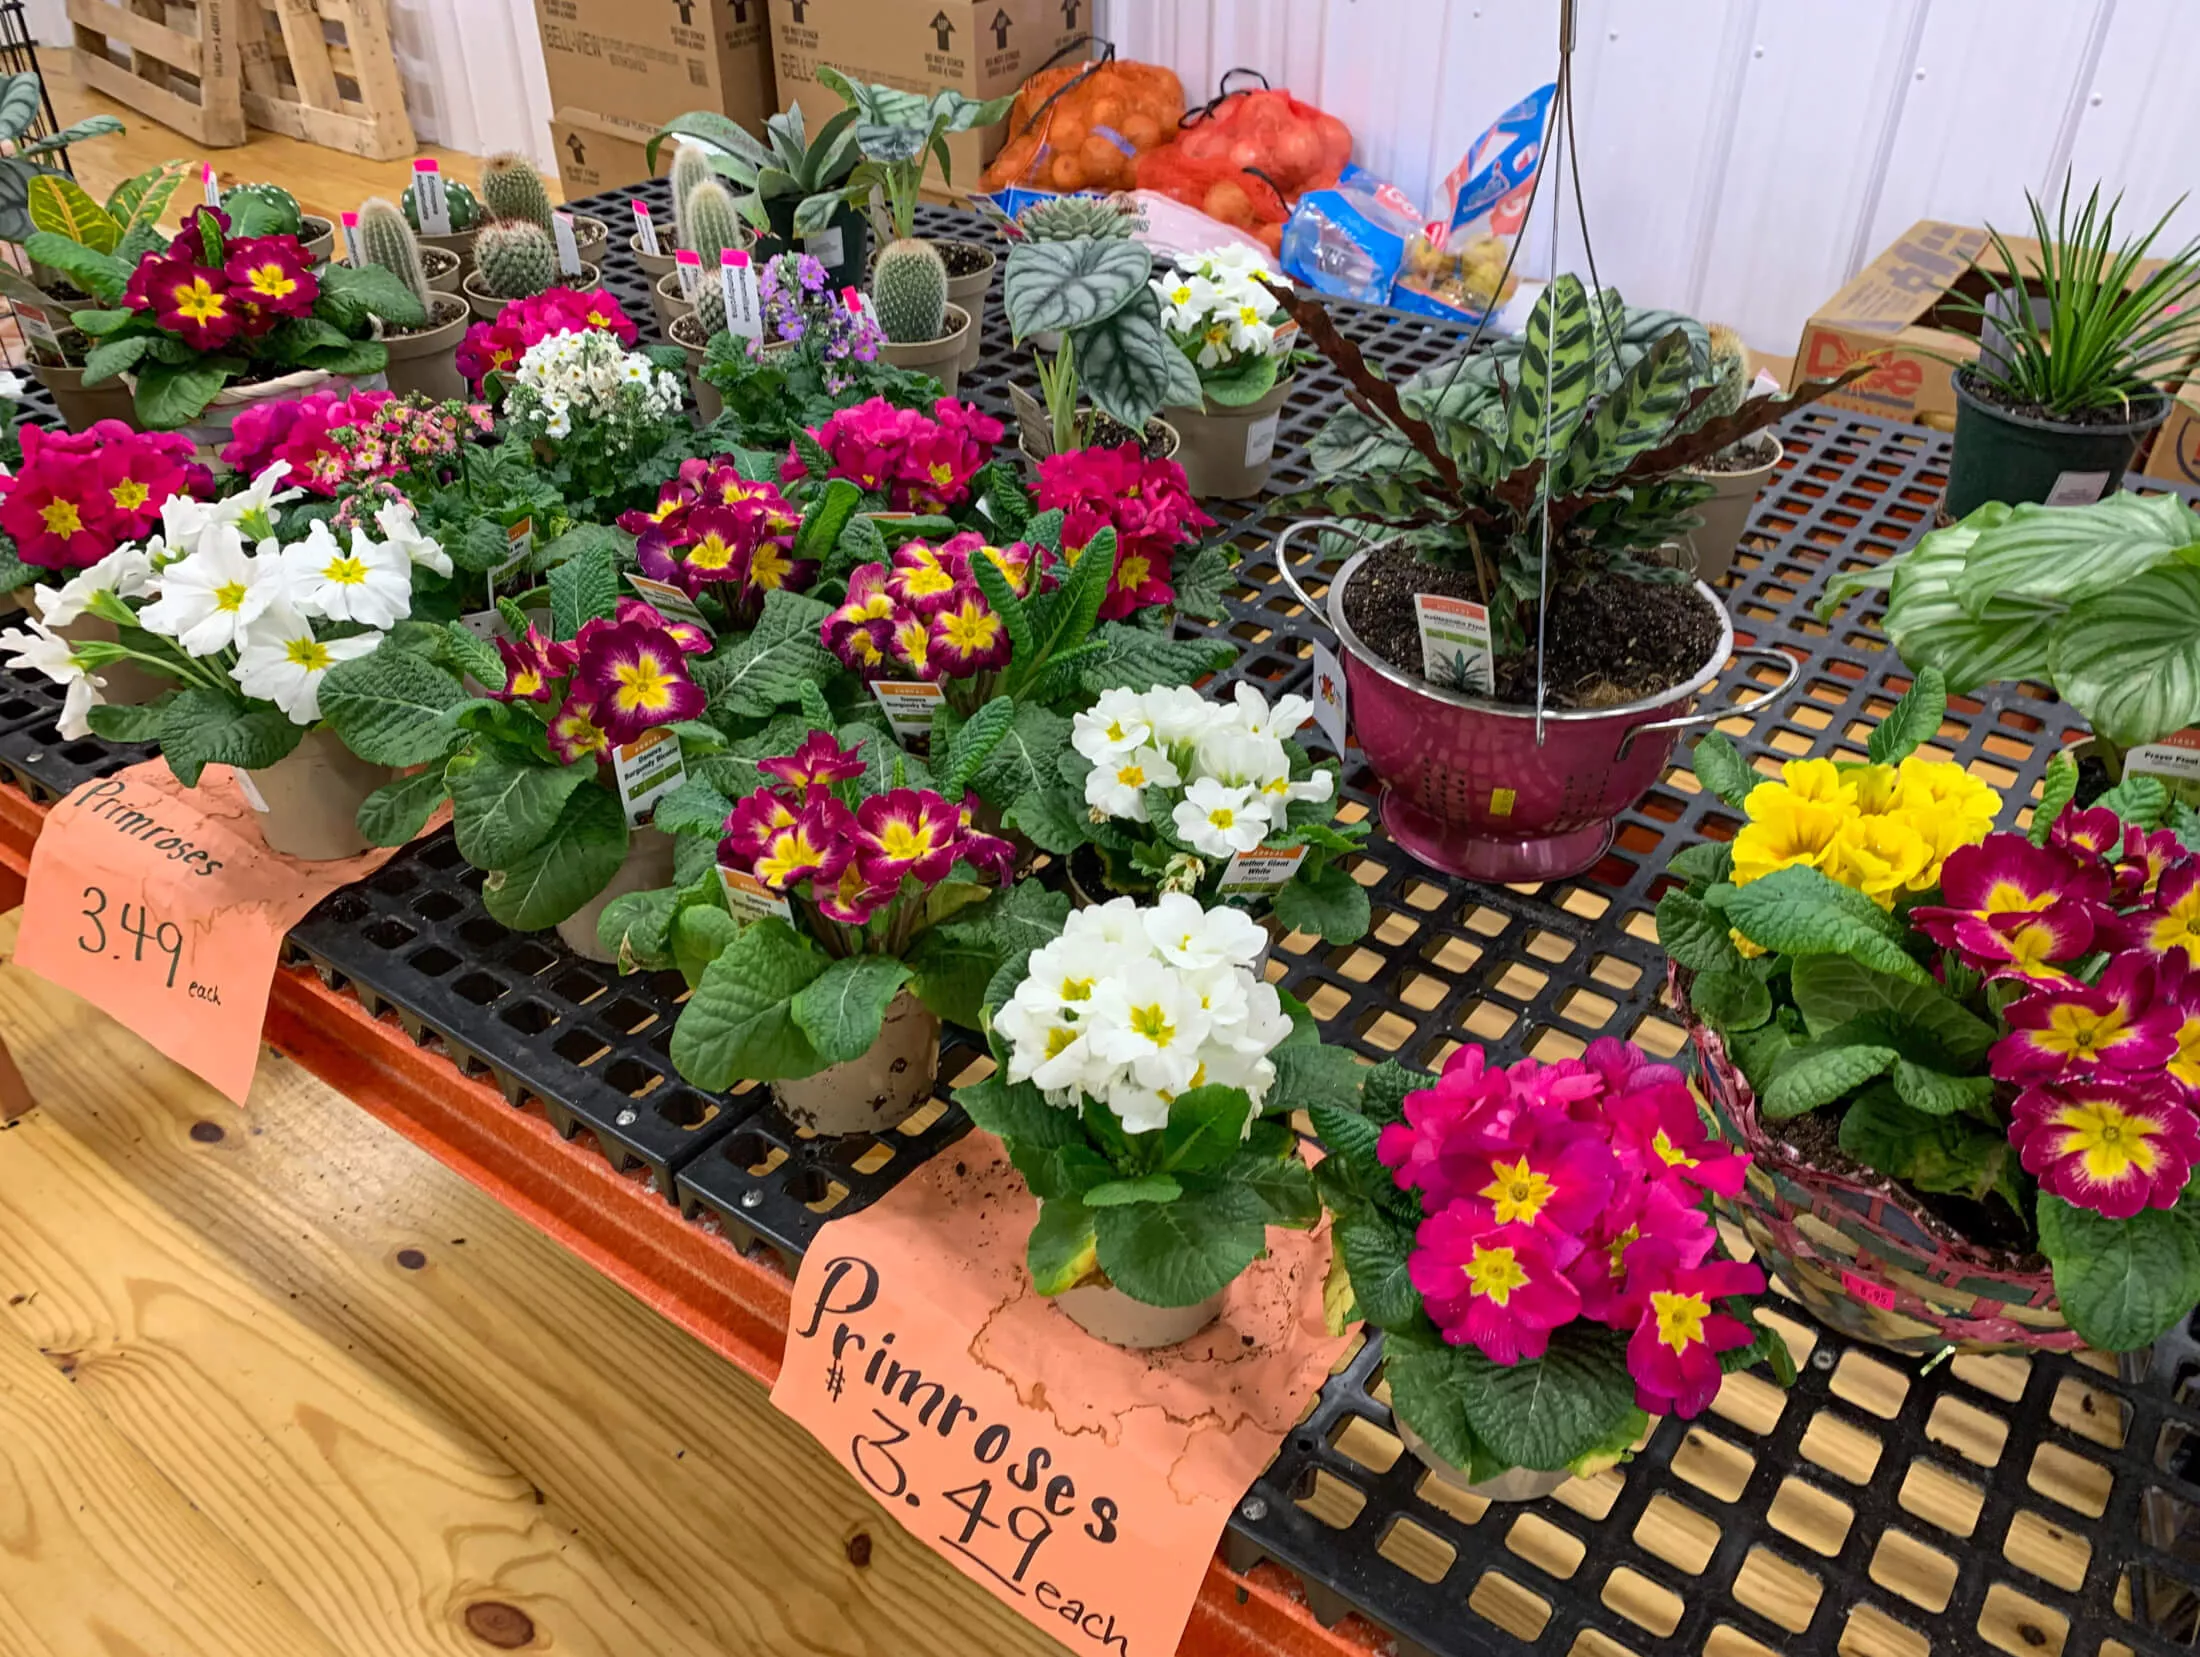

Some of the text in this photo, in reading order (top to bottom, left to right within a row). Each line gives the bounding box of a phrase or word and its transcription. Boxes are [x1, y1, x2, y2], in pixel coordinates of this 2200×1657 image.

[74, 779, 224, 876] Primroses
[77, 886, 184, 989] 3.49
[188, 979, 222, 1006] each
[796, 1256, 1119, 1545] Primroses
[851, 1408, 1054, 1583] 3.49
[1034, 1580, 1130, 1657] each
